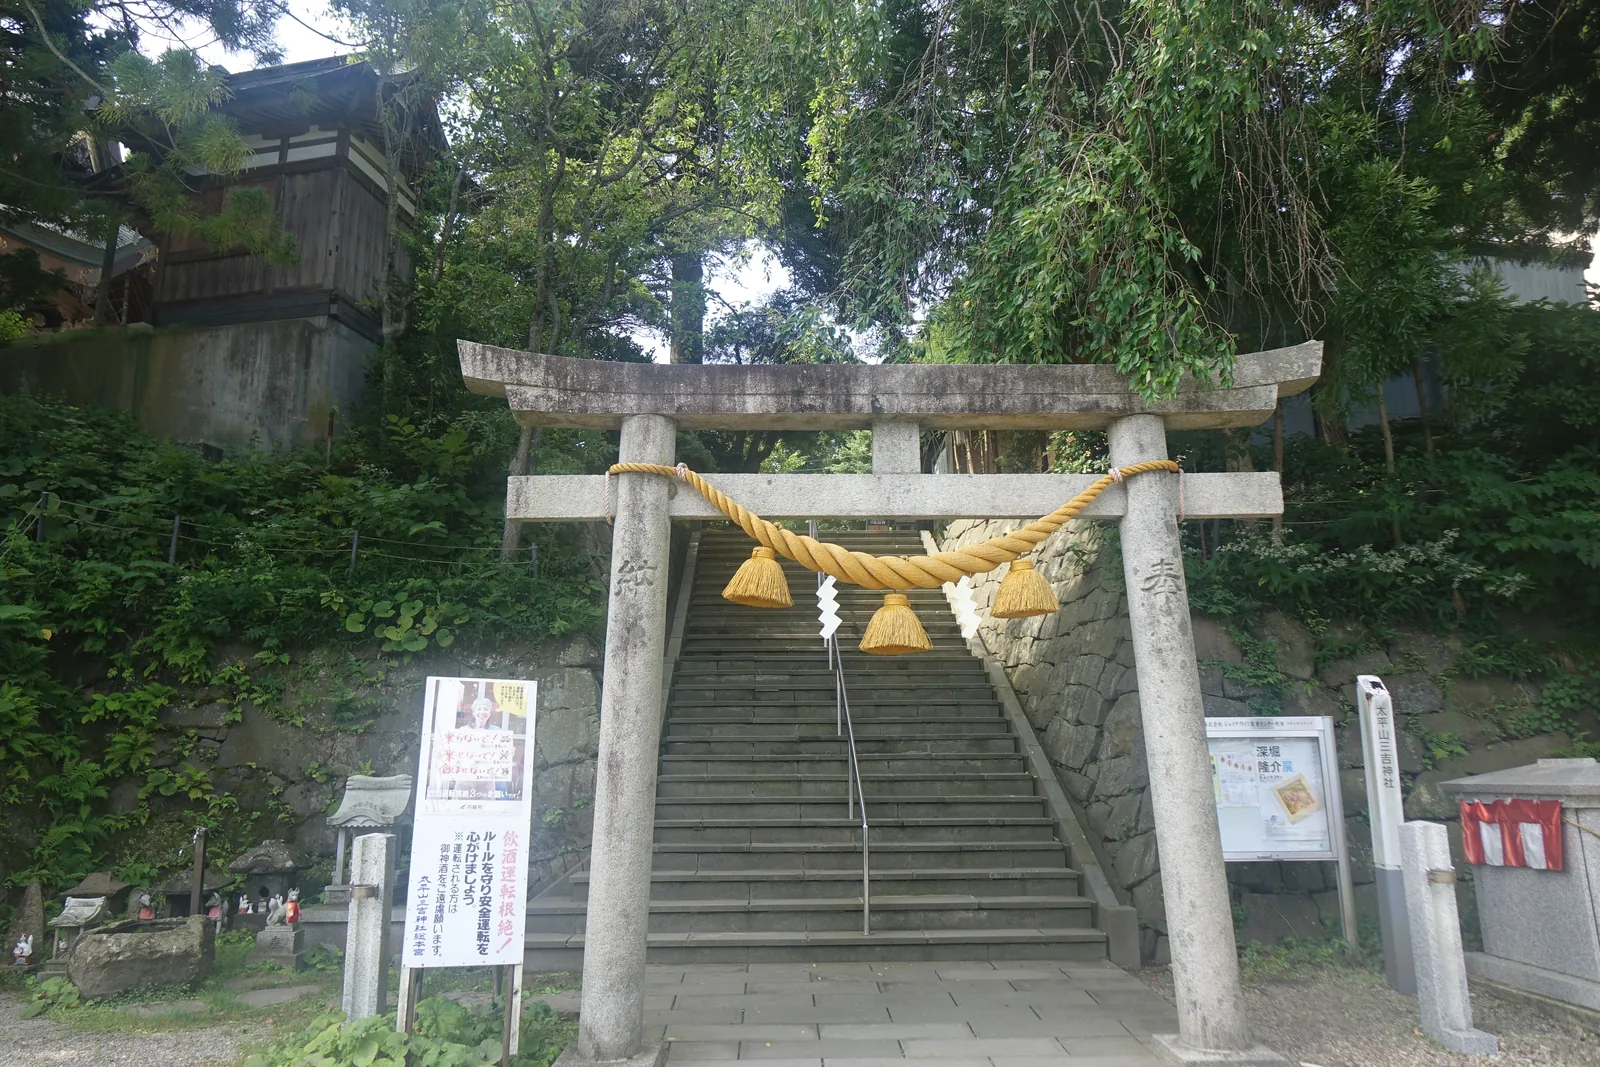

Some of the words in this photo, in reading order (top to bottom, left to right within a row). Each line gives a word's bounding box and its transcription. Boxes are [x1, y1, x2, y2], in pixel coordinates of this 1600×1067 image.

[1141, 558, 1183, 603] 奉
[1256, 745, 1281, 758] 深堀
[1257, 760, 1294, 773] 隆介展
[1375, 705, 1395, 789] 太平山三吉神社
[432, 843, 451, 957] 御神酒をご遠慮願います。
[462, 831, 481, 909] 心がけましょう。
[476, 831, 496, 956] ルールを守り安全運転を
[496, 830, 519, 954] 飲酒運転根絶！
[413, 875, 432, 956] 太平山三吉神社総本宮
